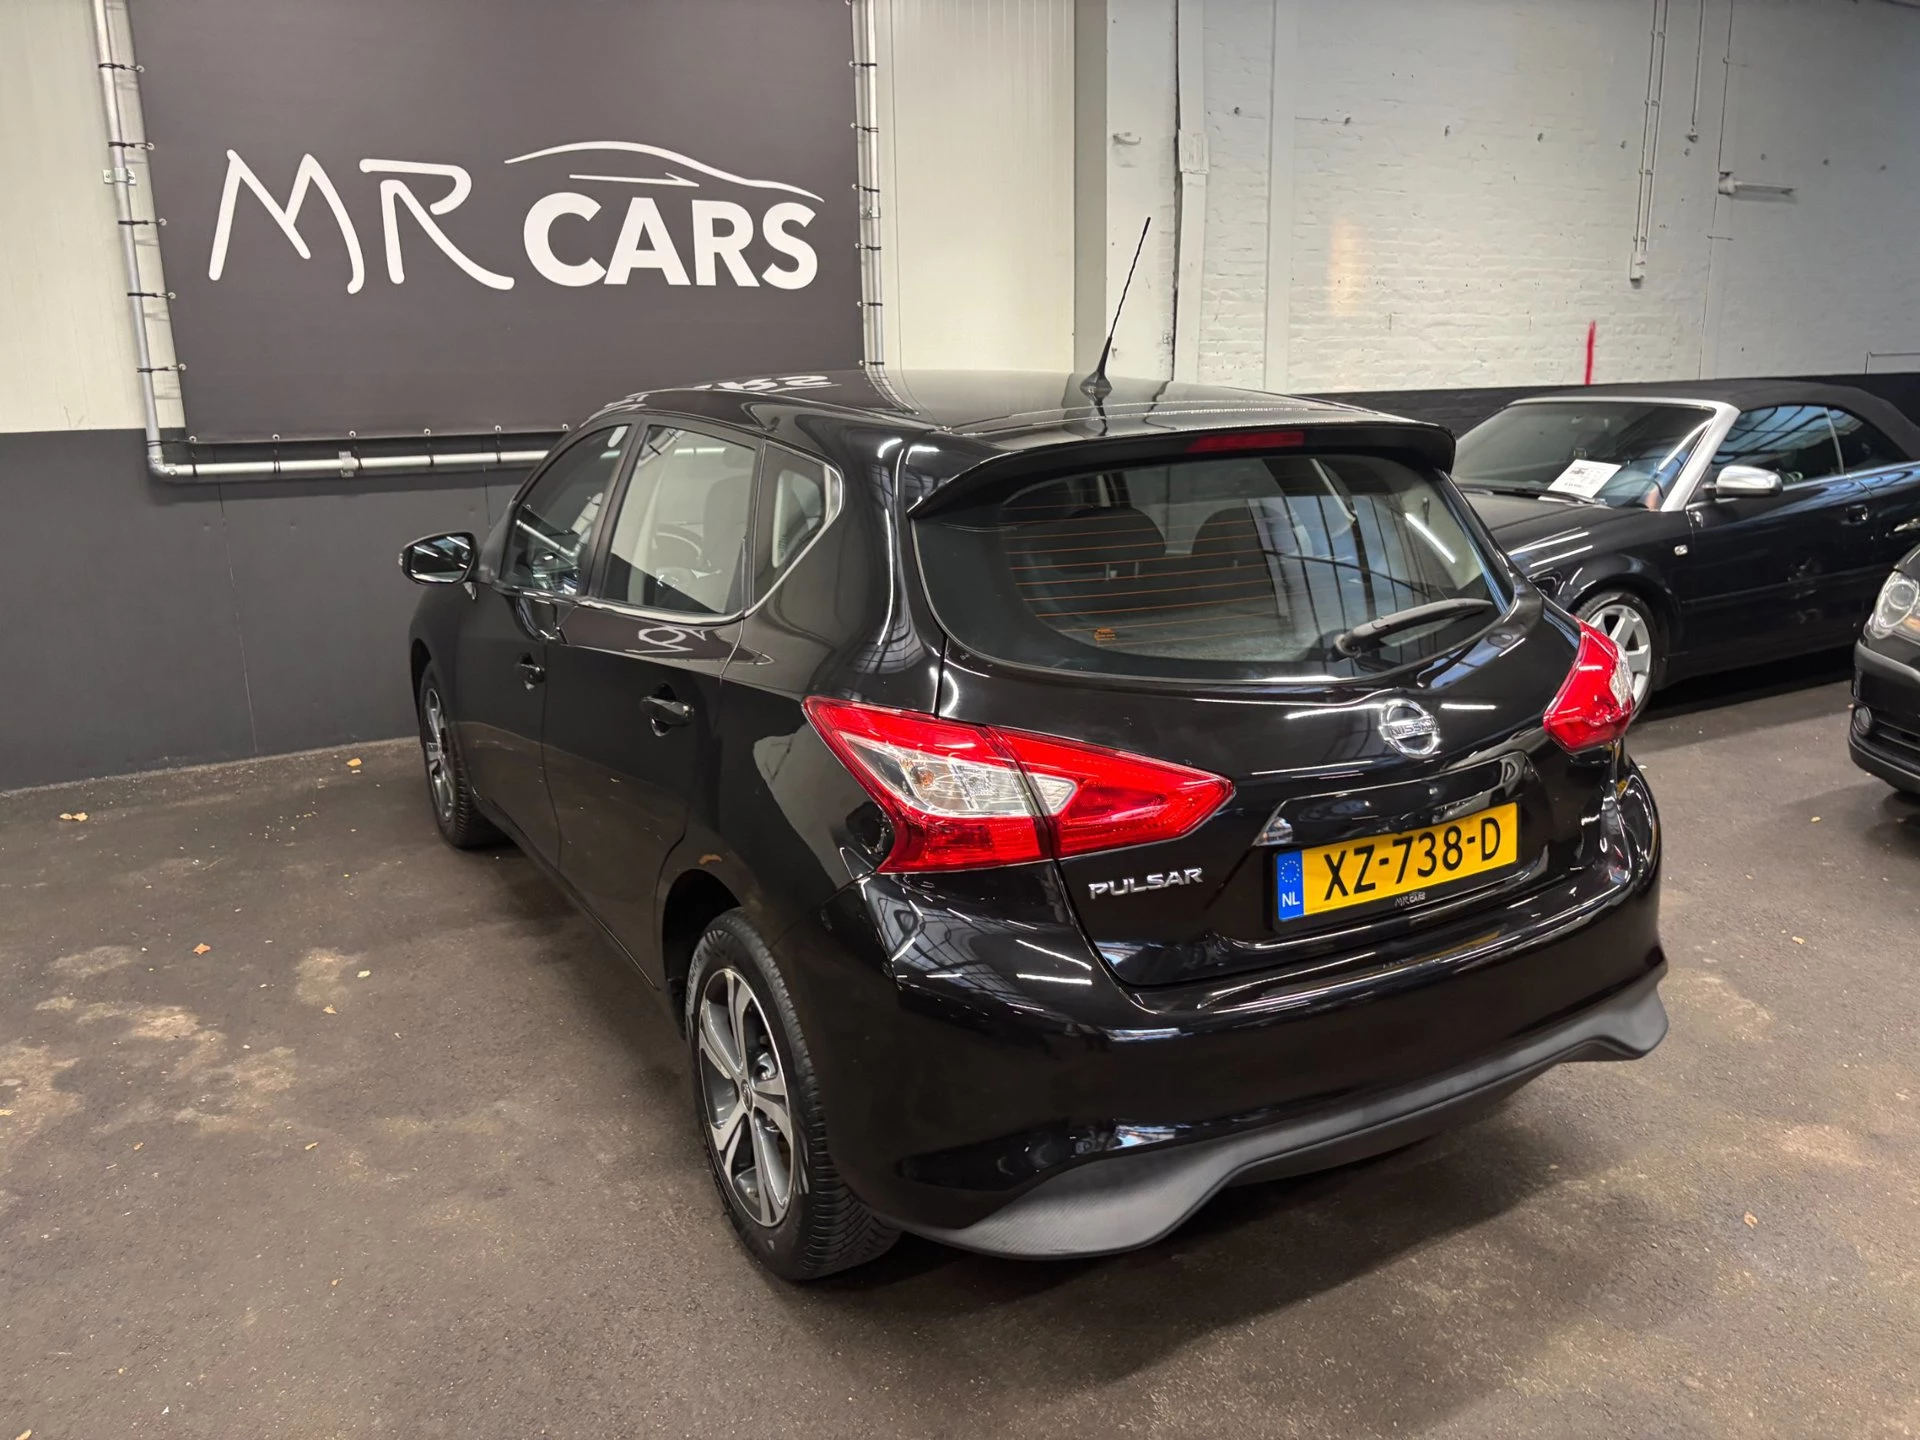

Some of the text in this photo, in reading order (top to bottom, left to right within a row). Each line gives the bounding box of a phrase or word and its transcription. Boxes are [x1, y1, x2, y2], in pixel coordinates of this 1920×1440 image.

[208, 148, 819, 295] MR CARS
[1088, 867, 1203, 900] PULSAR
[1323, 816, 1501, 902] XZ-738-D
[1281, 890, 1301, 908] NL
